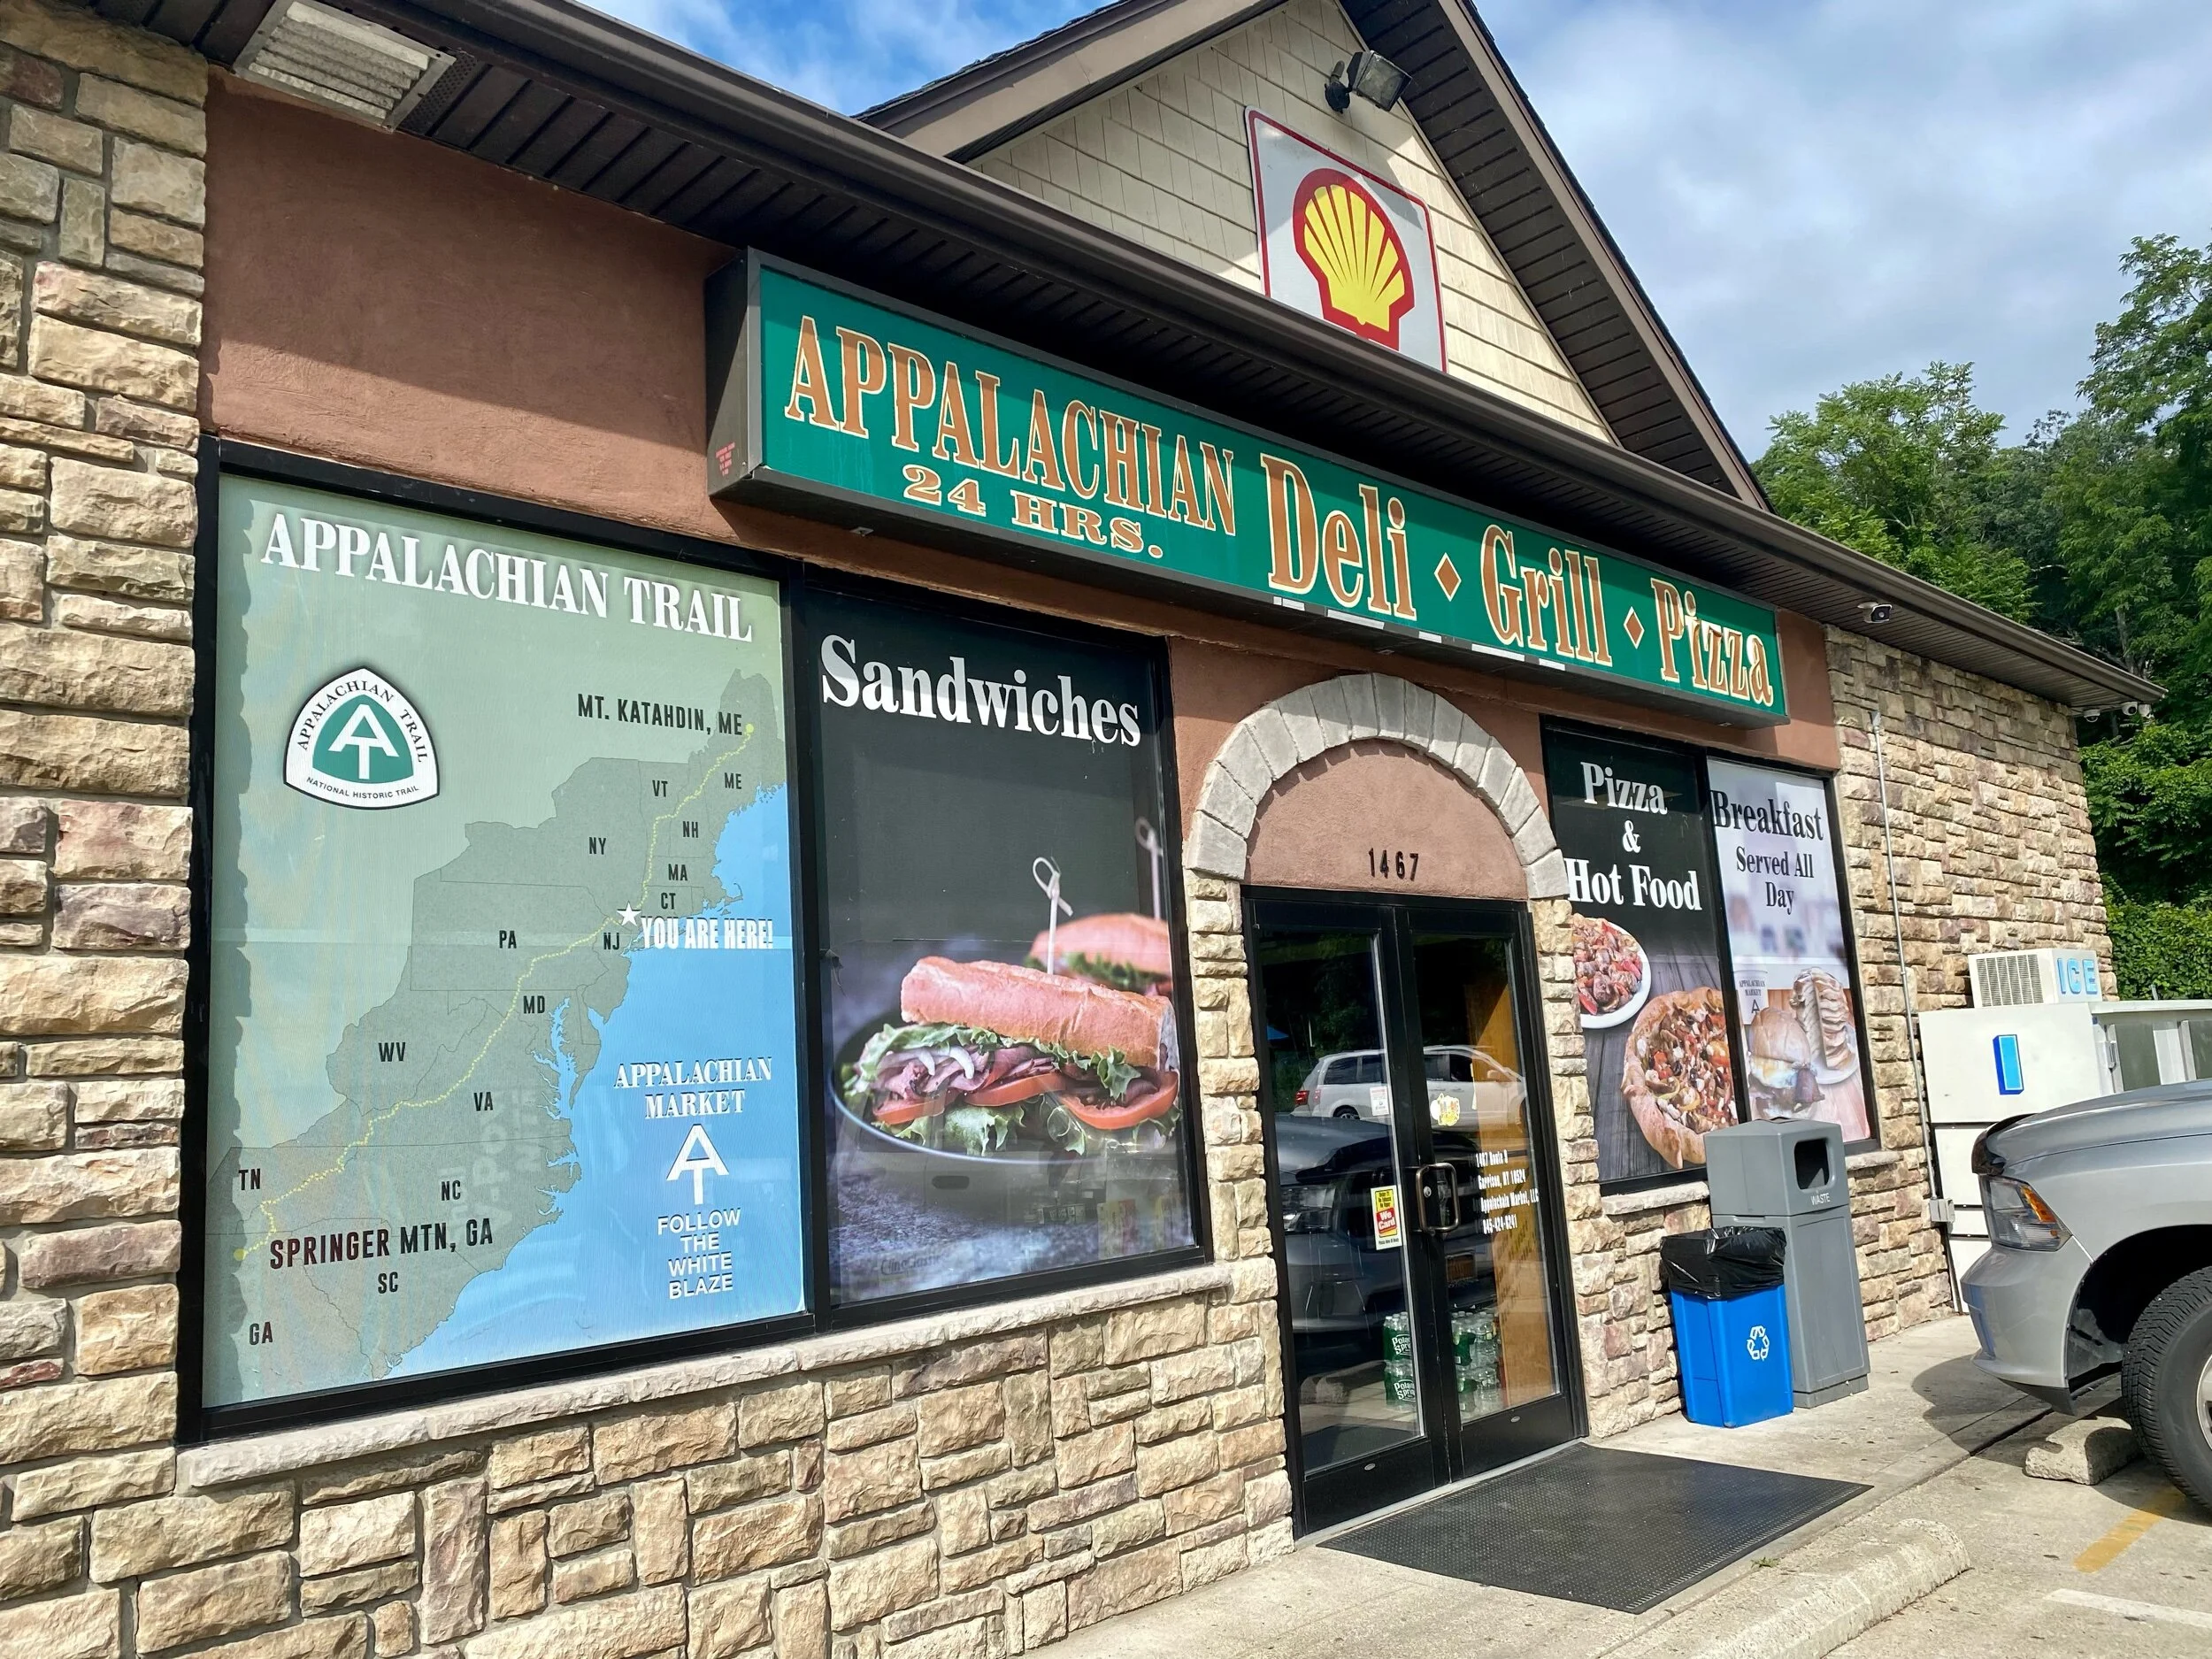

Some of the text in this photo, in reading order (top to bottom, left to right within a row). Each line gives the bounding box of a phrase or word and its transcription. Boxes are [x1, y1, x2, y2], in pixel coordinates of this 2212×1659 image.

[784, 315, 1236, 536] APPALACHIAN
[903, 465, 1164, 558] 24 HRS.
[260, 513, 753, 642] APPALACHIAN TRAIL
[1260, 453, 1774, 707] Deli Grill Pizza
[820, 634, 1141, 747] Sandwiches
[297, 680, 428, 763] APPALACHIAN TRAIL
[578, 693, 742, 735] MT. KATAHDIN, ME
[306, 777, 419, 800] NATIONAL HISTORIC TRAIL
[652, 780, 668, 797] VT
[724, 772, 742, 790] ME
[1580, 762, 1668, 815] Pizza
[1710, 789, 1824, 841] Breakfast
[682, 821, 699, 838] NH
[1622, 819, 1641, 853] &
[588, 837, 607, 855] NY
[668, 864, 688, 881] MA
[1368, 848, 1418, 881] 1467
[1736, 846, 1815, 878] Served All
[1563, 857, 1702, 910] Hot Food
[660, 892, 676, 910] CT
[1765, 881, 1794, 915] Day
[499, 930, 517, 949] PA
[603, 933, 620, 950] NJ
[641, 916, 774, 949] YOU ARE HERE!
[2057, 958, 2098, 995] ICE
[523, 995, 545, 1014] MD
[379, 1042, 406, 1062] WV
[613, 1056, 772, 1089] APPALACHIAN
[473, 1092, 494, 1111] VA
[645, 1089, 746, 1119] MARKET
[239, 1169, 261, 1190] TN
[442, 1180, 461, 1201] NC
[1530, 1187, 1540, 1202] LLC
[1810, 1193, 1831, 1205] WASTE
[657, 1207, 741, 1235] FOLLOW
[1379, 1210, 1393, 1221] We
[1379, 1217, 1395, 1231] Card
[270, 1217, 493, 1270] SPRINGER MTN, GA
[680, 1231, 720, 1254] THE
[668, 1251, 733, 1277] WHITE
[378, 1271, 399, 1294] SC
[669, 1272, 733, 1300] BLAZE
[249, 1322, 273, 1346] GA
